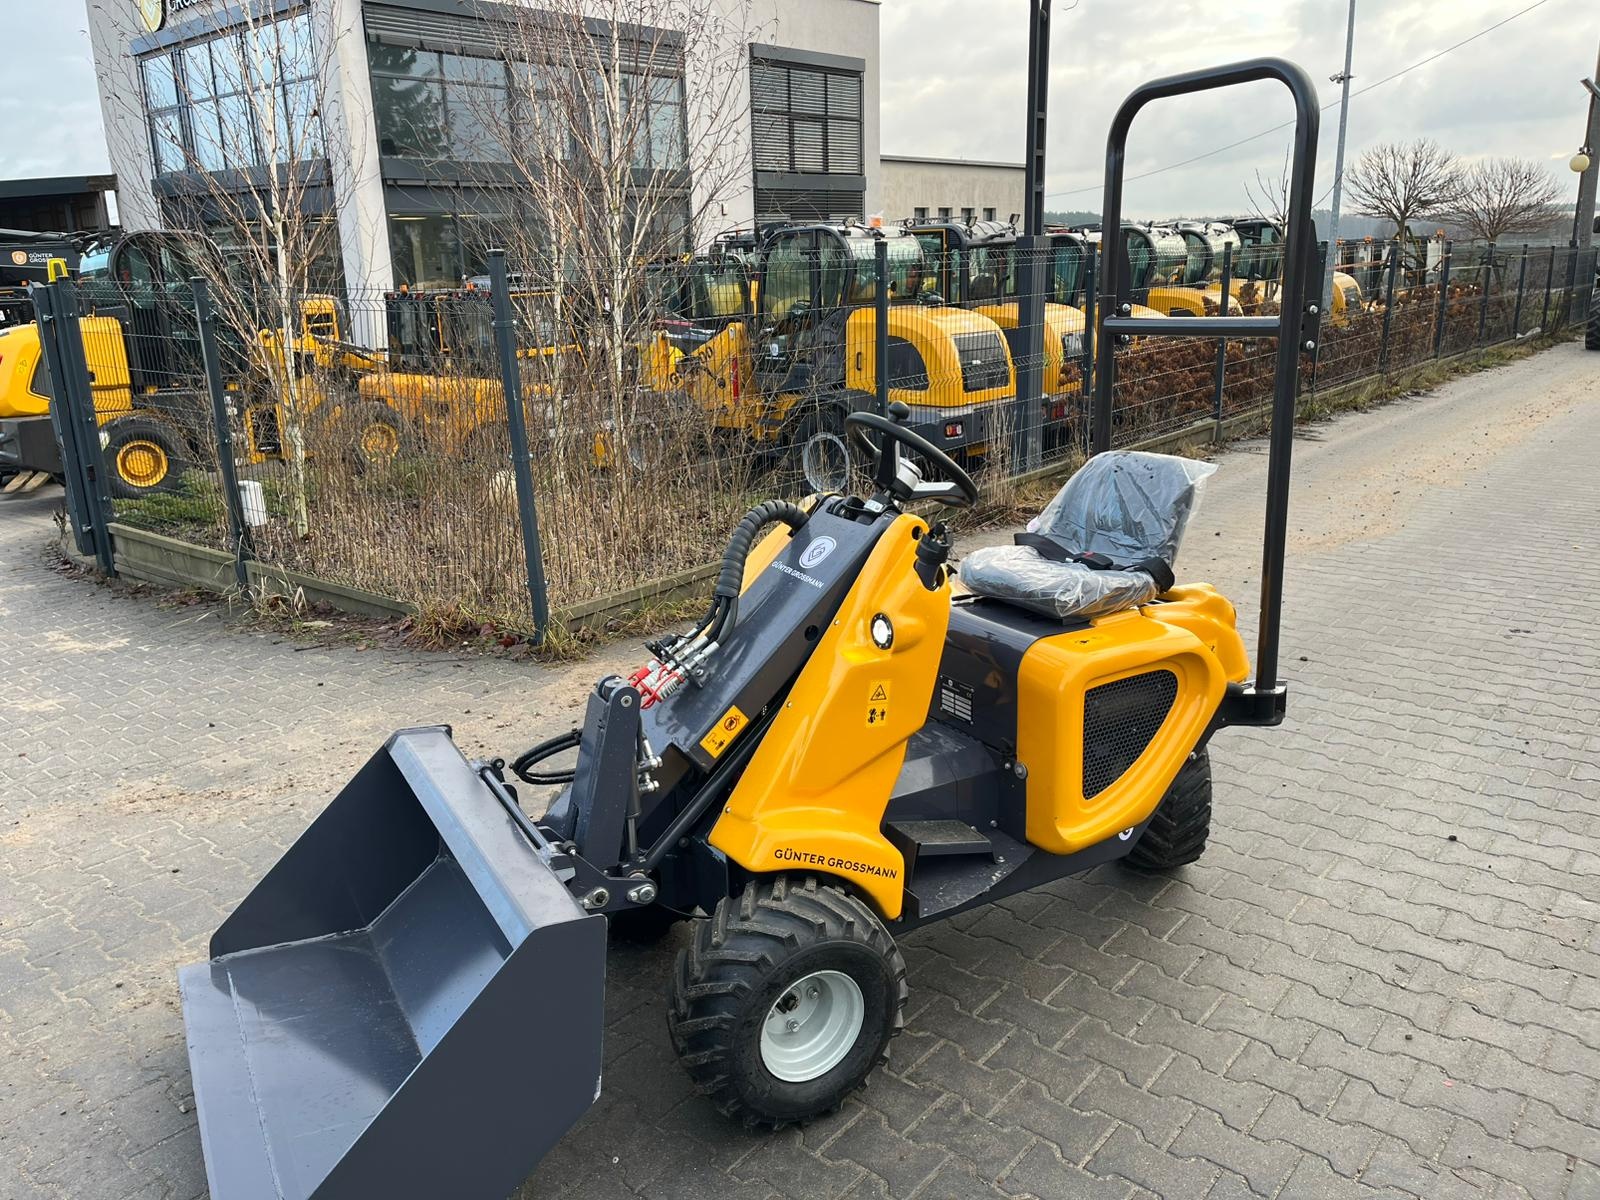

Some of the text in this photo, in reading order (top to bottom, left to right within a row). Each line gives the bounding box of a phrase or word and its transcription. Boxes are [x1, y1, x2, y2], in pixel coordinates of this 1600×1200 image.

[772, 560, 825, 588] GÜNTER GROSSMANN
[774, 848, 897, 879] GÜNTER GROSSMANN
